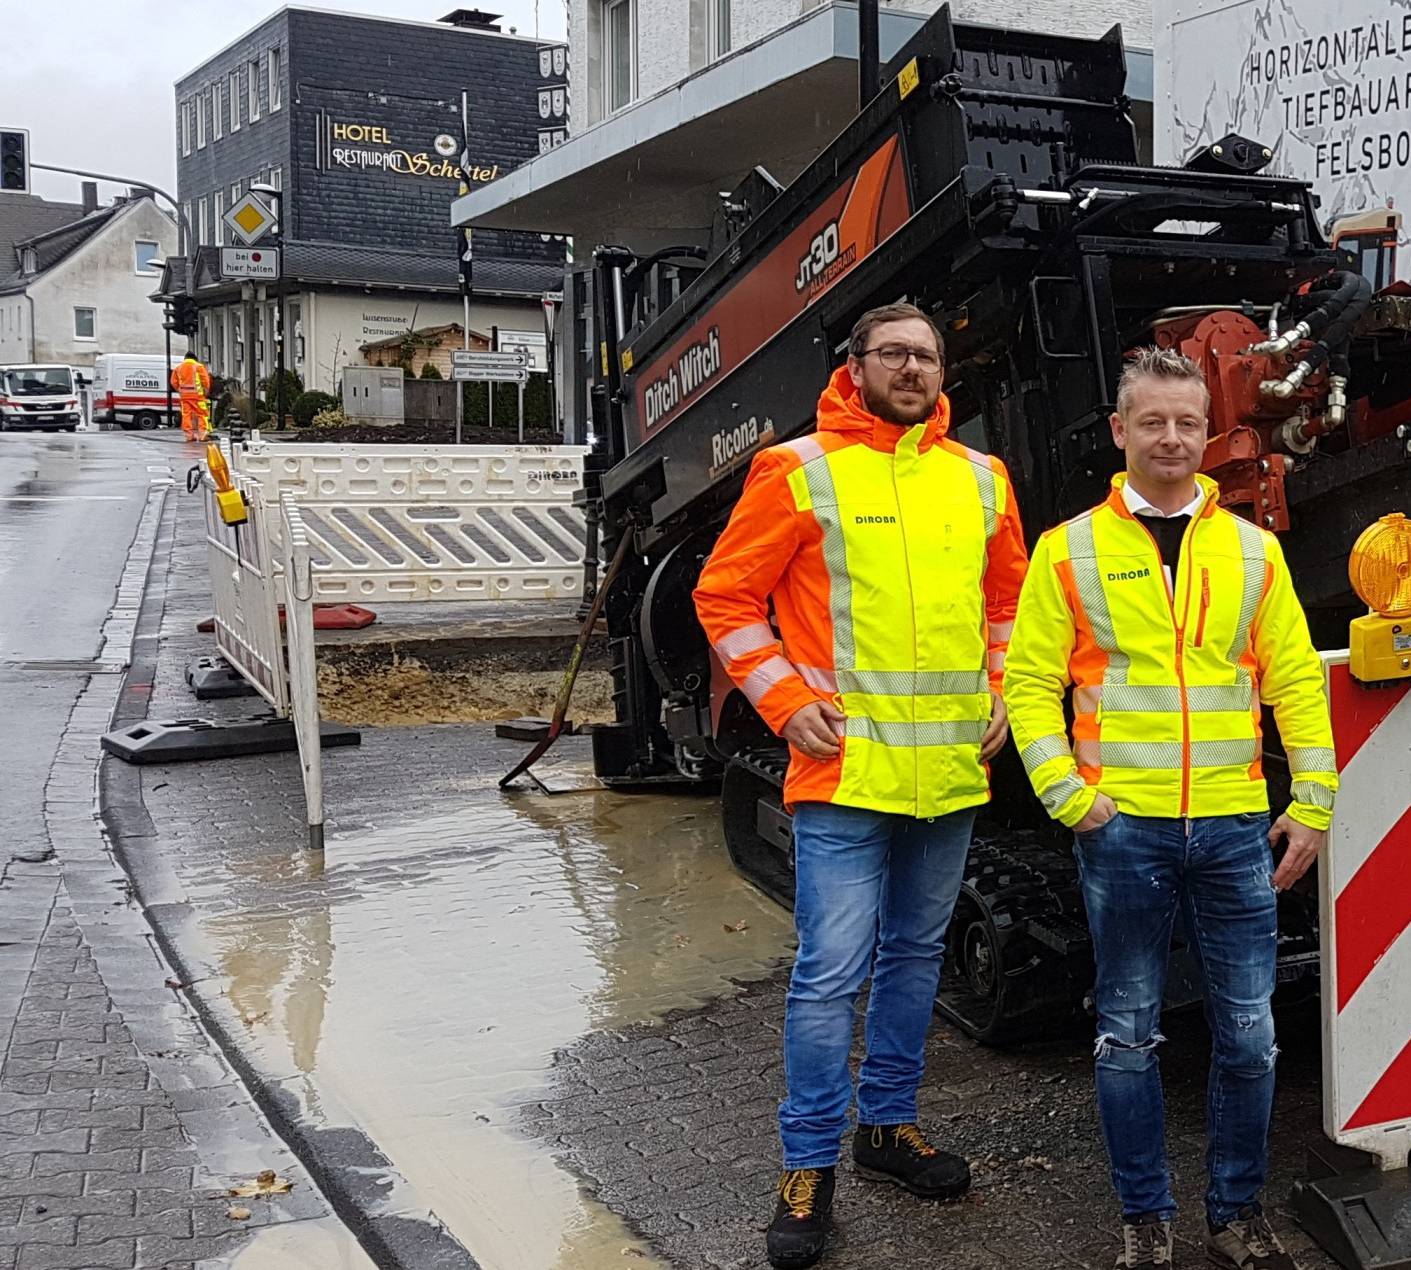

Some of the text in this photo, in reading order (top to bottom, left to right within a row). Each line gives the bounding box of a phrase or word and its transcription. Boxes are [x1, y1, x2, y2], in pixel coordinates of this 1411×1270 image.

[333, 122, 392, 144] HOTEL
[390, 150, 498, 182] Schetel
[226, 263, 274, 273] hier halten
[235, 252, 249, 260] bei
[796, 222, 839, 290] JT30
[823, 241, 857, 289] TERRAIN
[645, 328, 721, 428] Ditch Witch
[711, 415, 759, 469] Ricona
[855, 515, 896, 524] DIROBA
[1107, 567, 1150, 581] DIROBA
